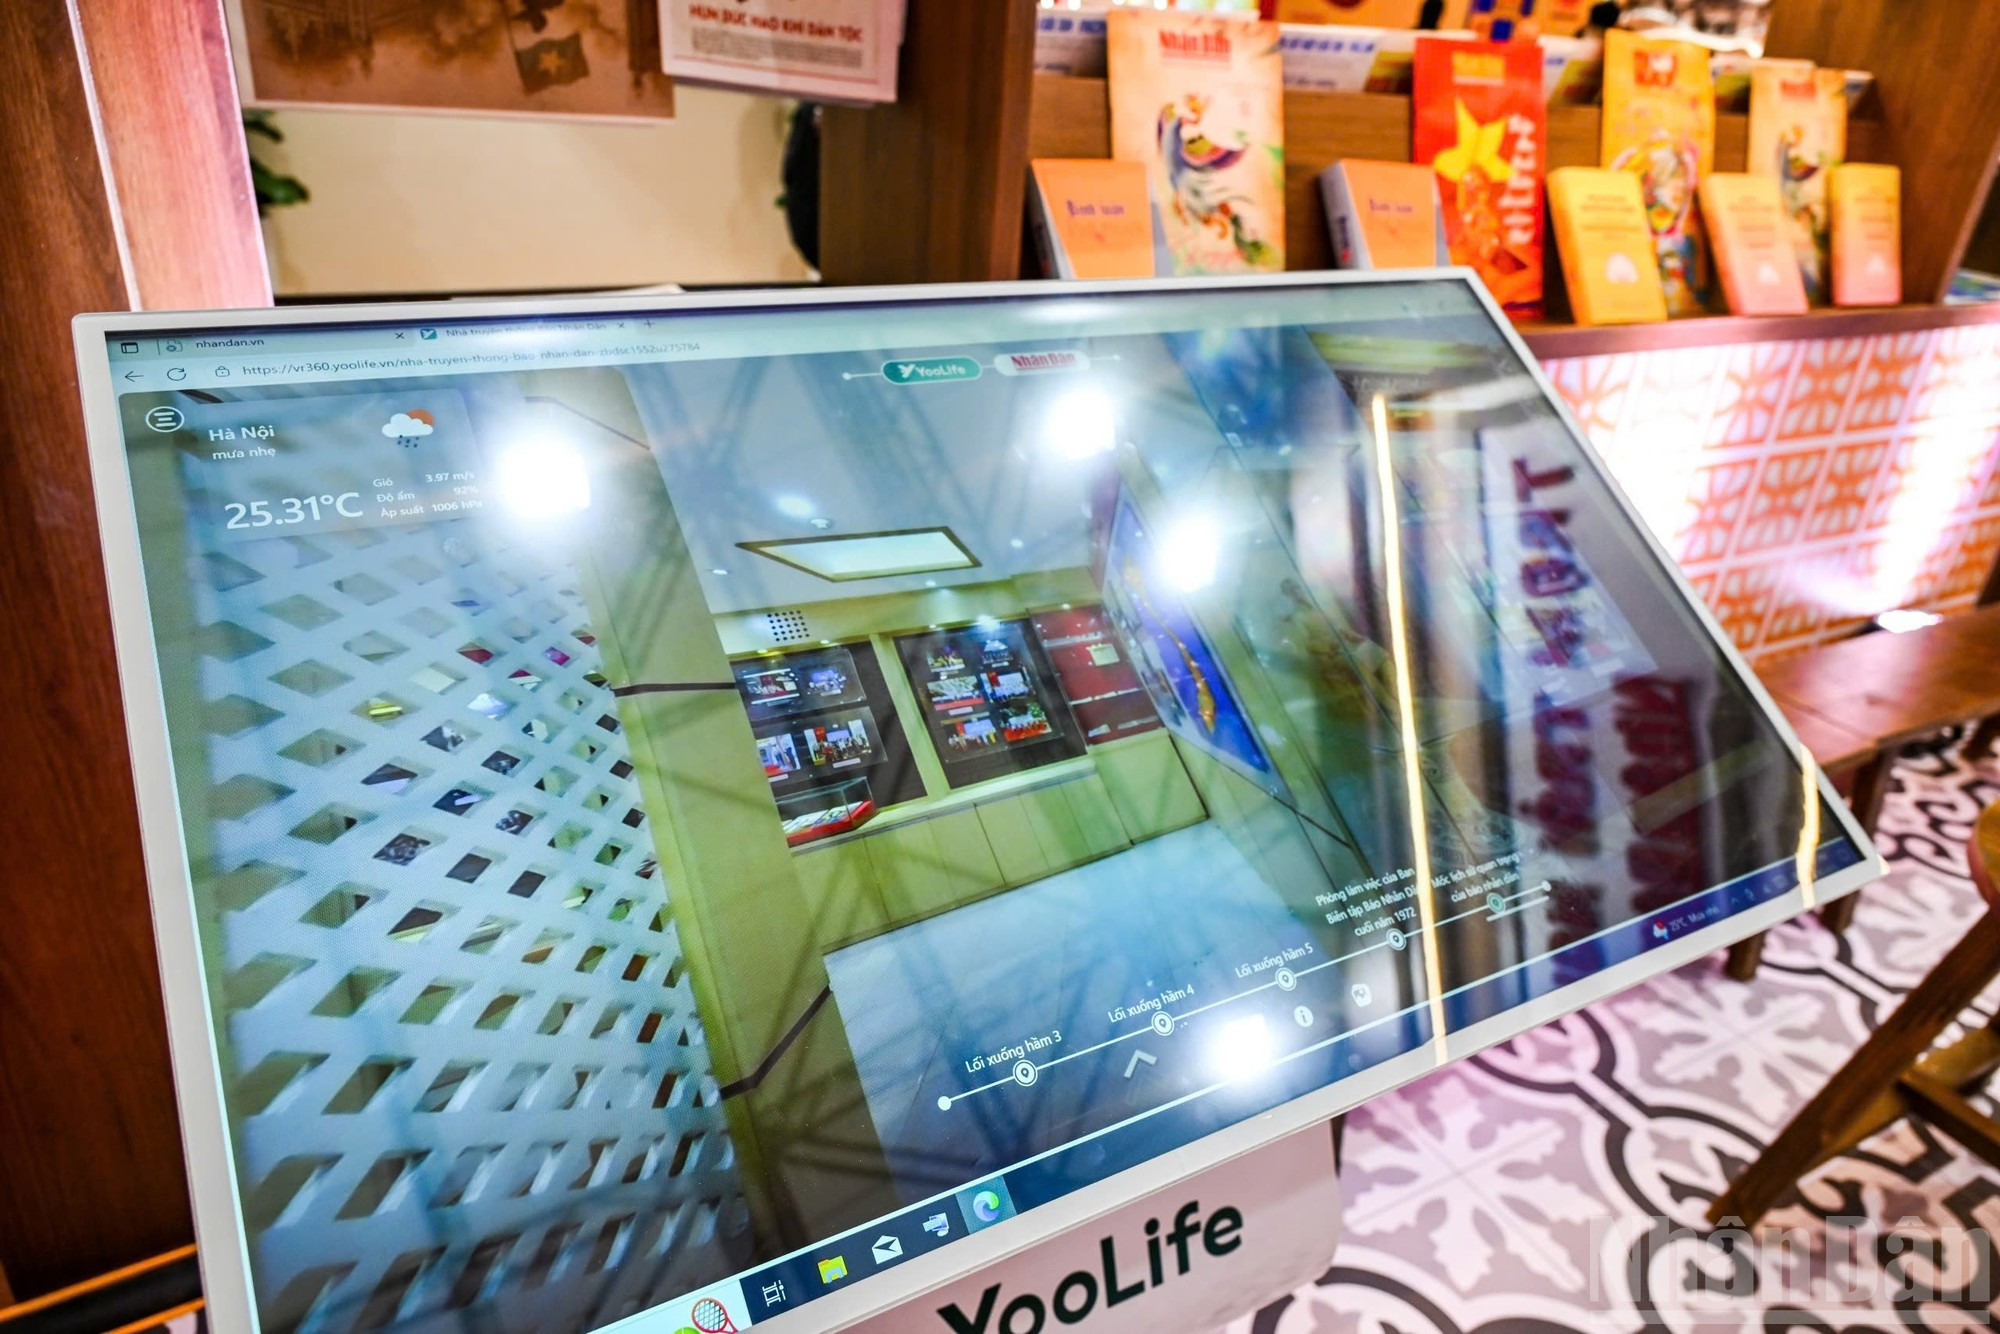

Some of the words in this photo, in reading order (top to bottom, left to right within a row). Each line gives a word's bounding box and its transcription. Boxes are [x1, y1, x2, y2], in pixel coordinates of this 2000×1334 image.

[195, 337, 265, 350] nhandan.vn
[914, 363, 966, 378] YooLife
[1011, 354, 1047, 369] Nhân
[208, 427, 236, 442] Hà
[241, 424, 276, 440] Nội
[212, 448, 245, 461] mưa
[249, 446, 277, 459] nhẹ
[372, 477, 394, 488] Gió
[425, 472, 450, 484] 3.97
[452, 470, 476, 482] m/s
[376, 492, 394, 504] Độ
[400, 503, 425, 516] suất
[431, 502, 459, 514] 1006
[1315, 890, 1348, 907] Phòng
[1344, 884, 1365, 897] làm
[1363, 877, 1383, 891] việc
[1396, 867, 1416, 880] Ban
[1325, 909, 1348, 925] Biên
[1347, 904, 1365, 919] tập
[1361, 898, 1382, 913] Báo
[1380, 890, 1407, 907] Nhân
[1374, 915, 1395, 930] năm
[1394, 906, 1418, 922] 1972
[1235, 962, 1253, 979] Lối
[1252, 955, 1285, 974] xuống
[1304, 941, 1315, 955] 5
[1107, 1006, 1127, 1023] Lối
[1127, 998, 1163, 1017] xuống
[1160, 989, 1187, 1005] hầm
[1186, 983, 1196, 995] 4
[965, 1055, 986, 1073] Lối
[986, 1046, 1026, 1067] xuống
[1024, 1036, 1053, 1053] hầm
[1052, 1029, 1063, 1043] 3
[935, 1199, 1245, 1334] YooLife
